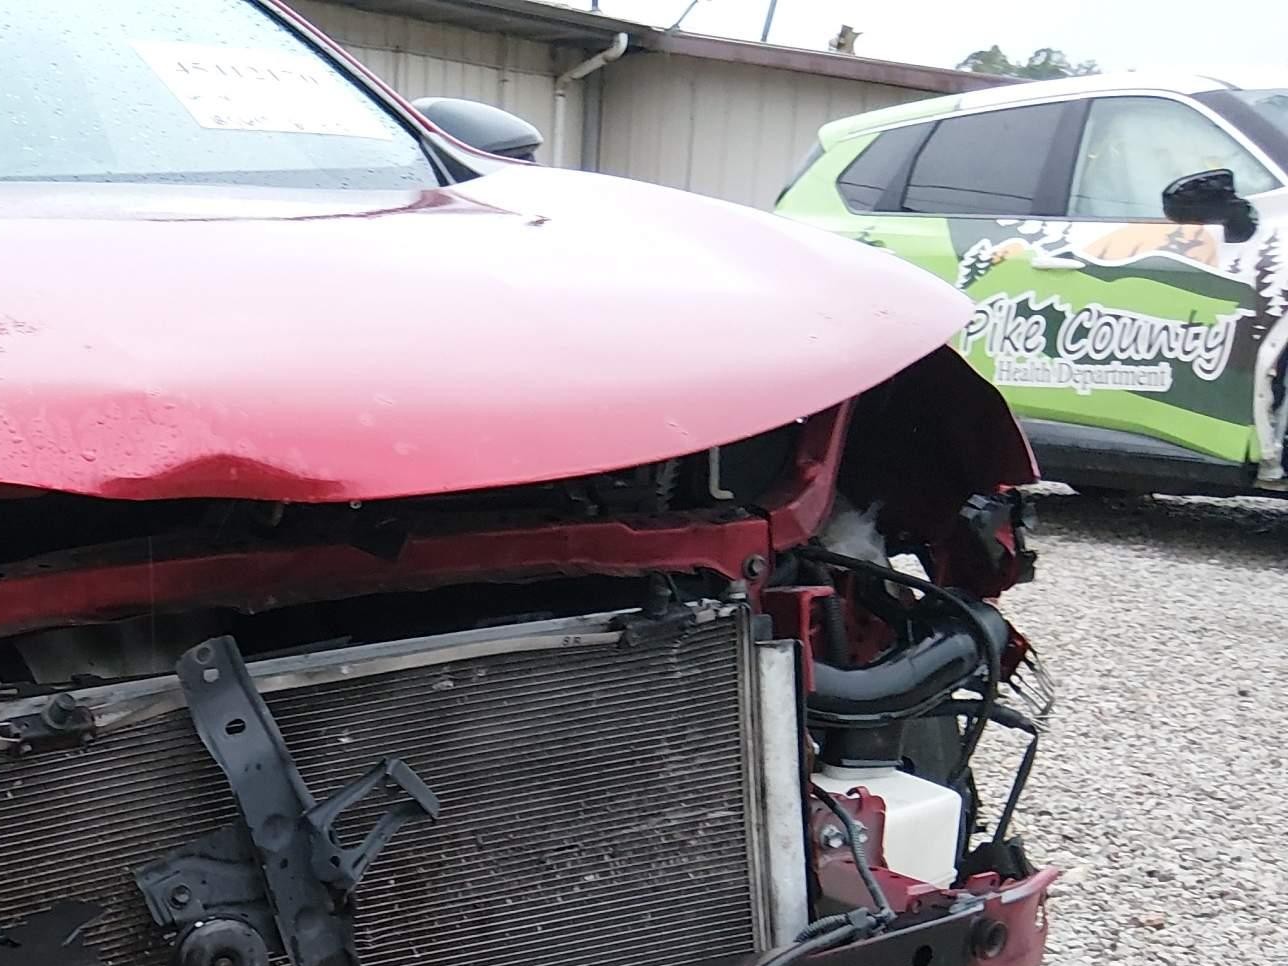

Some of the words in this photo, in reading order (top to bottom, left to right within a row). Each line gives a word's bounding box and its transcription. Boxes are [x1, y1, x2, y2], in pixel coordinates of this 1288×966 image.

[963, 301, 1043, 354] Pike
[1062, 306, 1231, 375] County
[997, 360, 1052, 384] Health
[1056, 361, 1167, 390] Department
